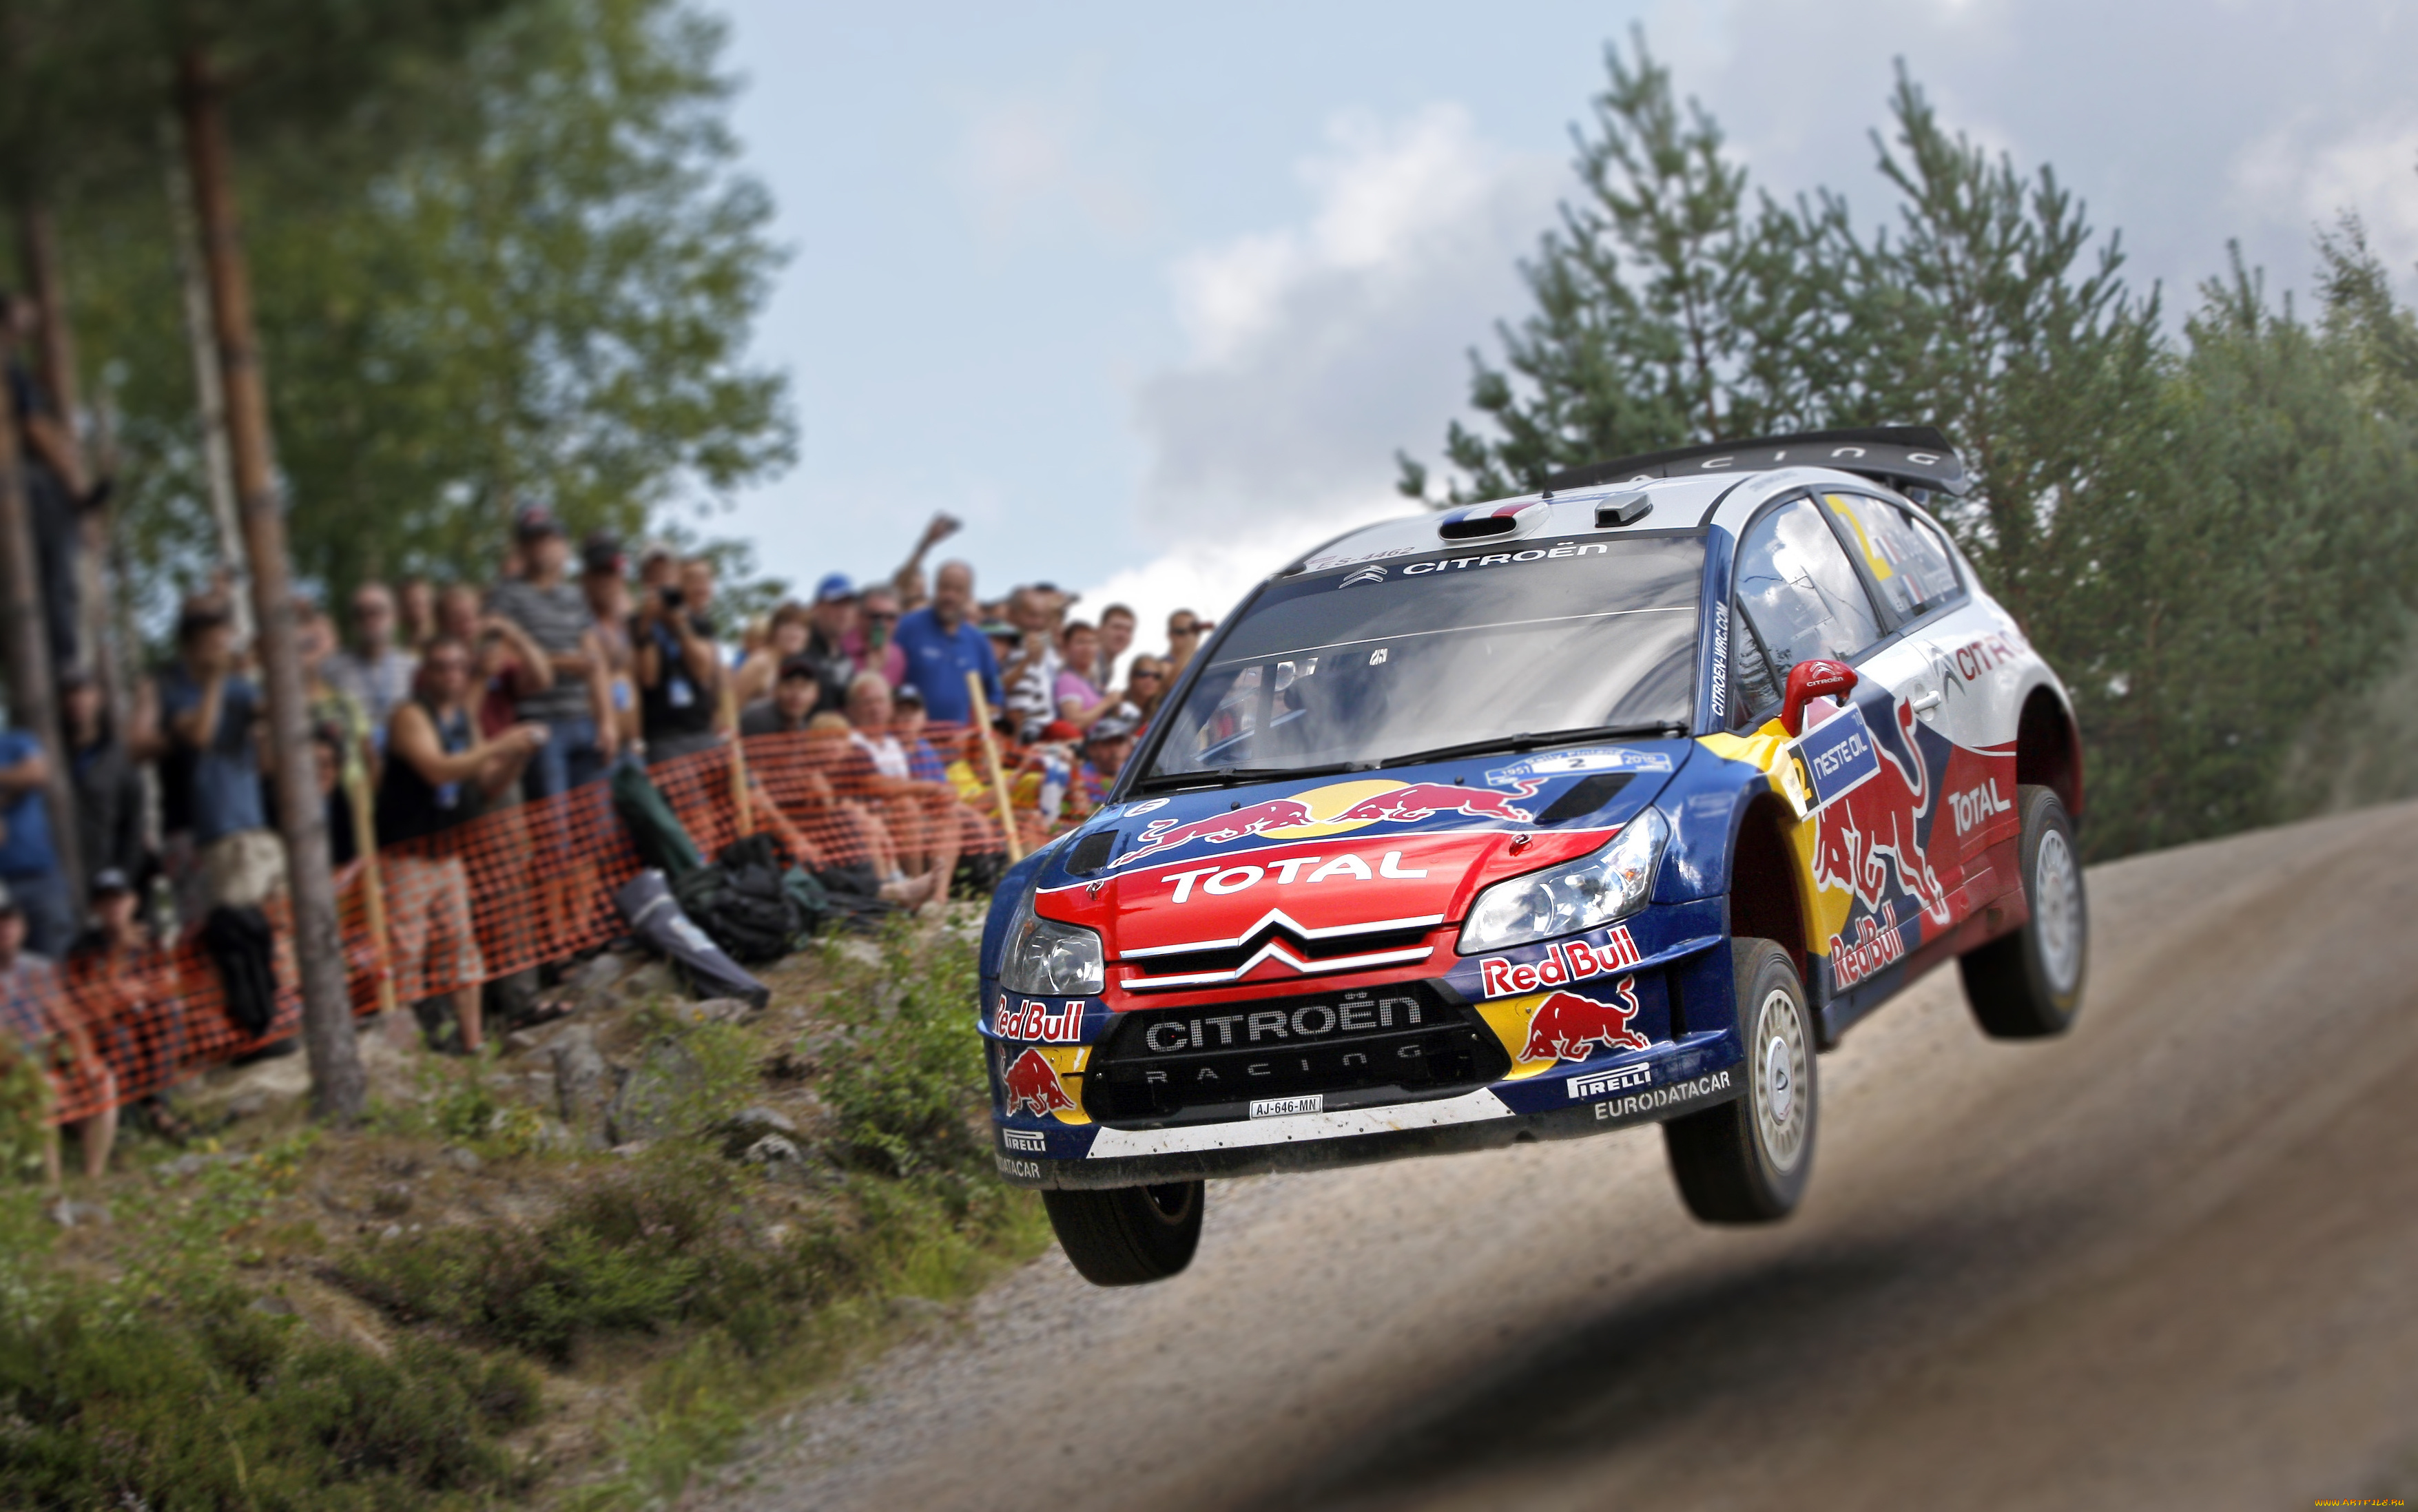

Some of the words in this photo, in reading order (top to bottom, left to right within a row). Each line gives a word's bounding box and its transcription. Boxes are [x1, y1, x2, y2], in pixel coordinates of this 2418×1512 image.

[1826, 494, 1893, 582] 2
[1711, 601, 1730, 717] CITROEN-WRC.COM
[1568, 757, 1587, 769] 2
[1624, 754, 1657, 766] 2010
[1793, 757, 1812, 801] 2
[1813, 741, 1853, 780] NESTE
[1850, 733, 1868, 756] OIL
[1948, 777, 2011, 836] TOTAL
[1161, 850, 1428, 904] TOTAL
[1480, 944, 1569, 998] Red
[1564, 924, 1642, 980] Bull
[1830, 917, 1872, 991] Red
[1861, 900, 1904, 971] Bull
[993, 994, 1029, 1039] Red
[1024, 1001, 1085, 1042] Bull
[1566, 1061, 1652, 1099] PIRELLI
[1594, 1071, 1731, 1120] EURODATACAR
[1255, 1099, 1317, 1117] AJ-646-MN
[1002, 1128, 1046, 1152] PIRELLI
